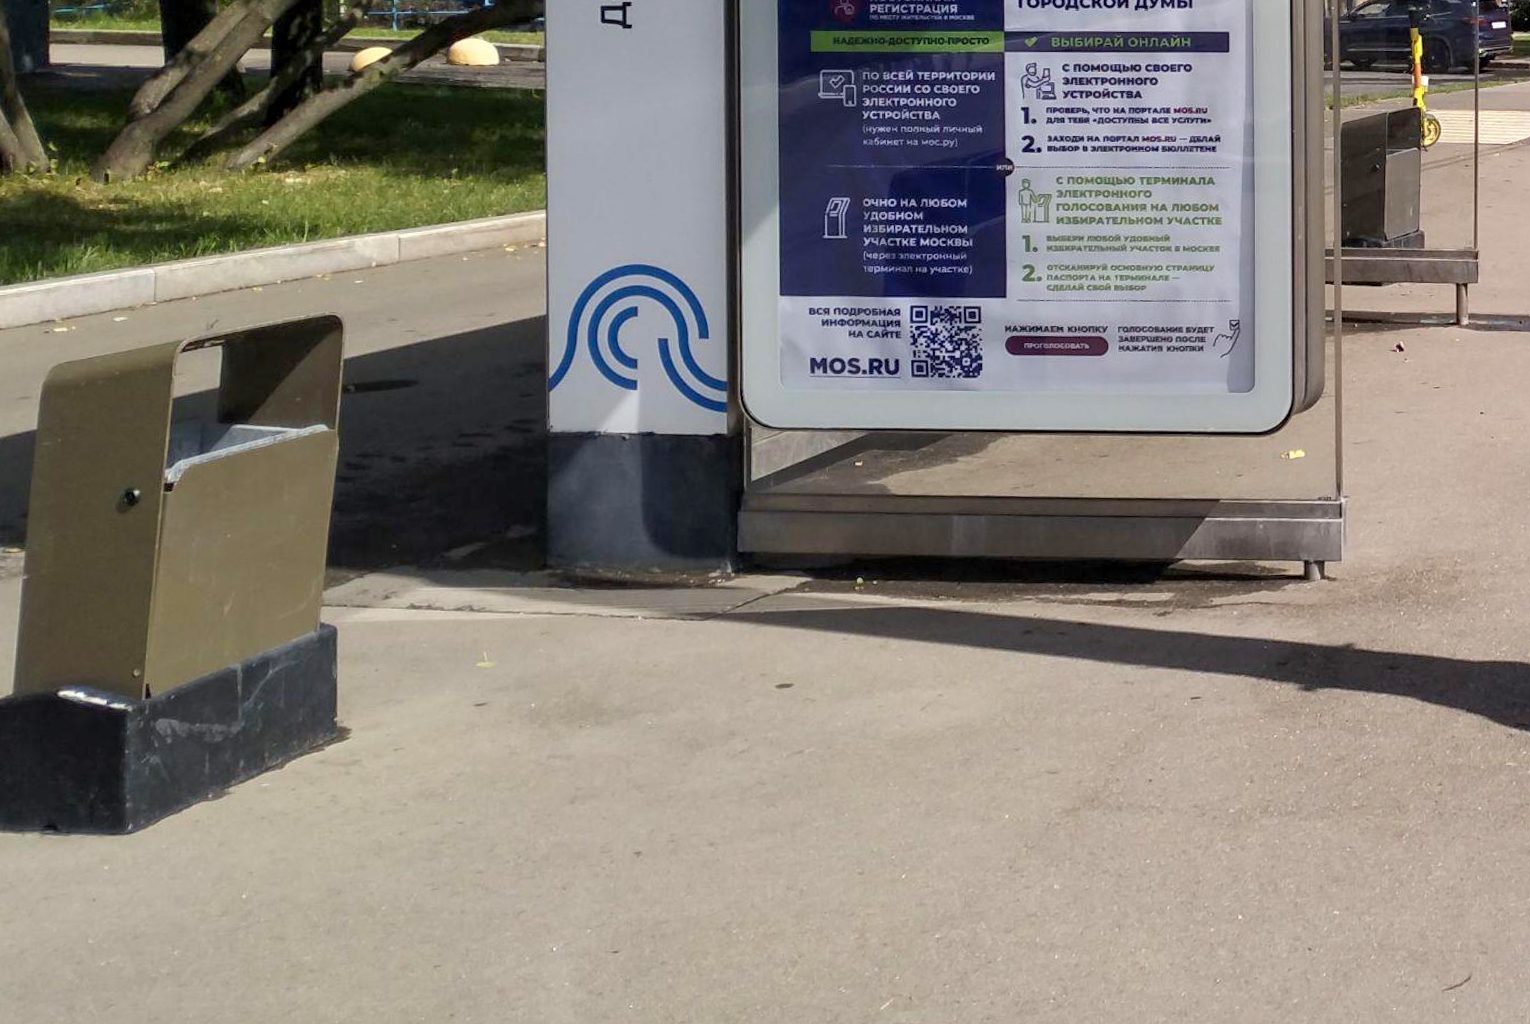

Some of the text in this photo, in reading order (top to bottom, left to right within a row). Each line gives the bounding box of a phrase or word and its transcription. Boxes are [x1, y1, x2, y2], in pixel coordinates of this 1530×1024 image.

[870, 4, 957, 14] РЕГИСТРАЦИЯ
[1052, 36, 1191, 47] ВЫБИРАЙ ОНЛАЙН
[1062, 64, 1192, 74] С ПОМОЩЬЮ СВОЕГО
[863, 70, 995, 80] ПО ВСЕЙ ТЕРРИТОРИИ
[1062, 78, 1158, 86] ЭЛЕКТРОННОГО
[863, 85, 980, 94] РОССИИ СО СВОЕГО
[1062, 89, 1142, 99] УСТРОЙСТВА
[862, 98, 957, 106] ЭЛЕКТРОННОГО
[862, 110, 940, 119] УСТРОЙСТВА
[1021, 107, 1037, 124] 1.
[1021, 136, 1042, 153] 2.
[1056, 177, 1215, 186] С ПОМОЩЬЮ ТЕРМИНАЛА
[1056, 190, 1152, 198] ЭЛЕКТРОННОГО
[863, 199, 967, 207] ОЧНО НА ЛЮБОМ
[1056, 203, 1219, 212] ГОЛОСОВАНИЯ НА ЛЮБОМ
[864, 212, 923, 221] УДОБНОМ
[1057, 217, 1222, 225] ИЗБИРАТЕЛЬНОМ УЧАСТКЕ
[863, 225, 968, 234] ИЗБИРАТЕЛЬНОМ
[863, 238, 973, 247] УЧАСТКЕ МОСКВЫ
[1023, 235, 1038, 252] 1.
[1022, 264, 1042, 282] 2.
[834, 308, 900, 317] ПОДРОБНАЯ
[821, 319, 900, 329] ИНФОРМАЦИЯ
[867, 329, 901, 339] САЙТЕ
[810, 357, 899, 375] MOS.RU
